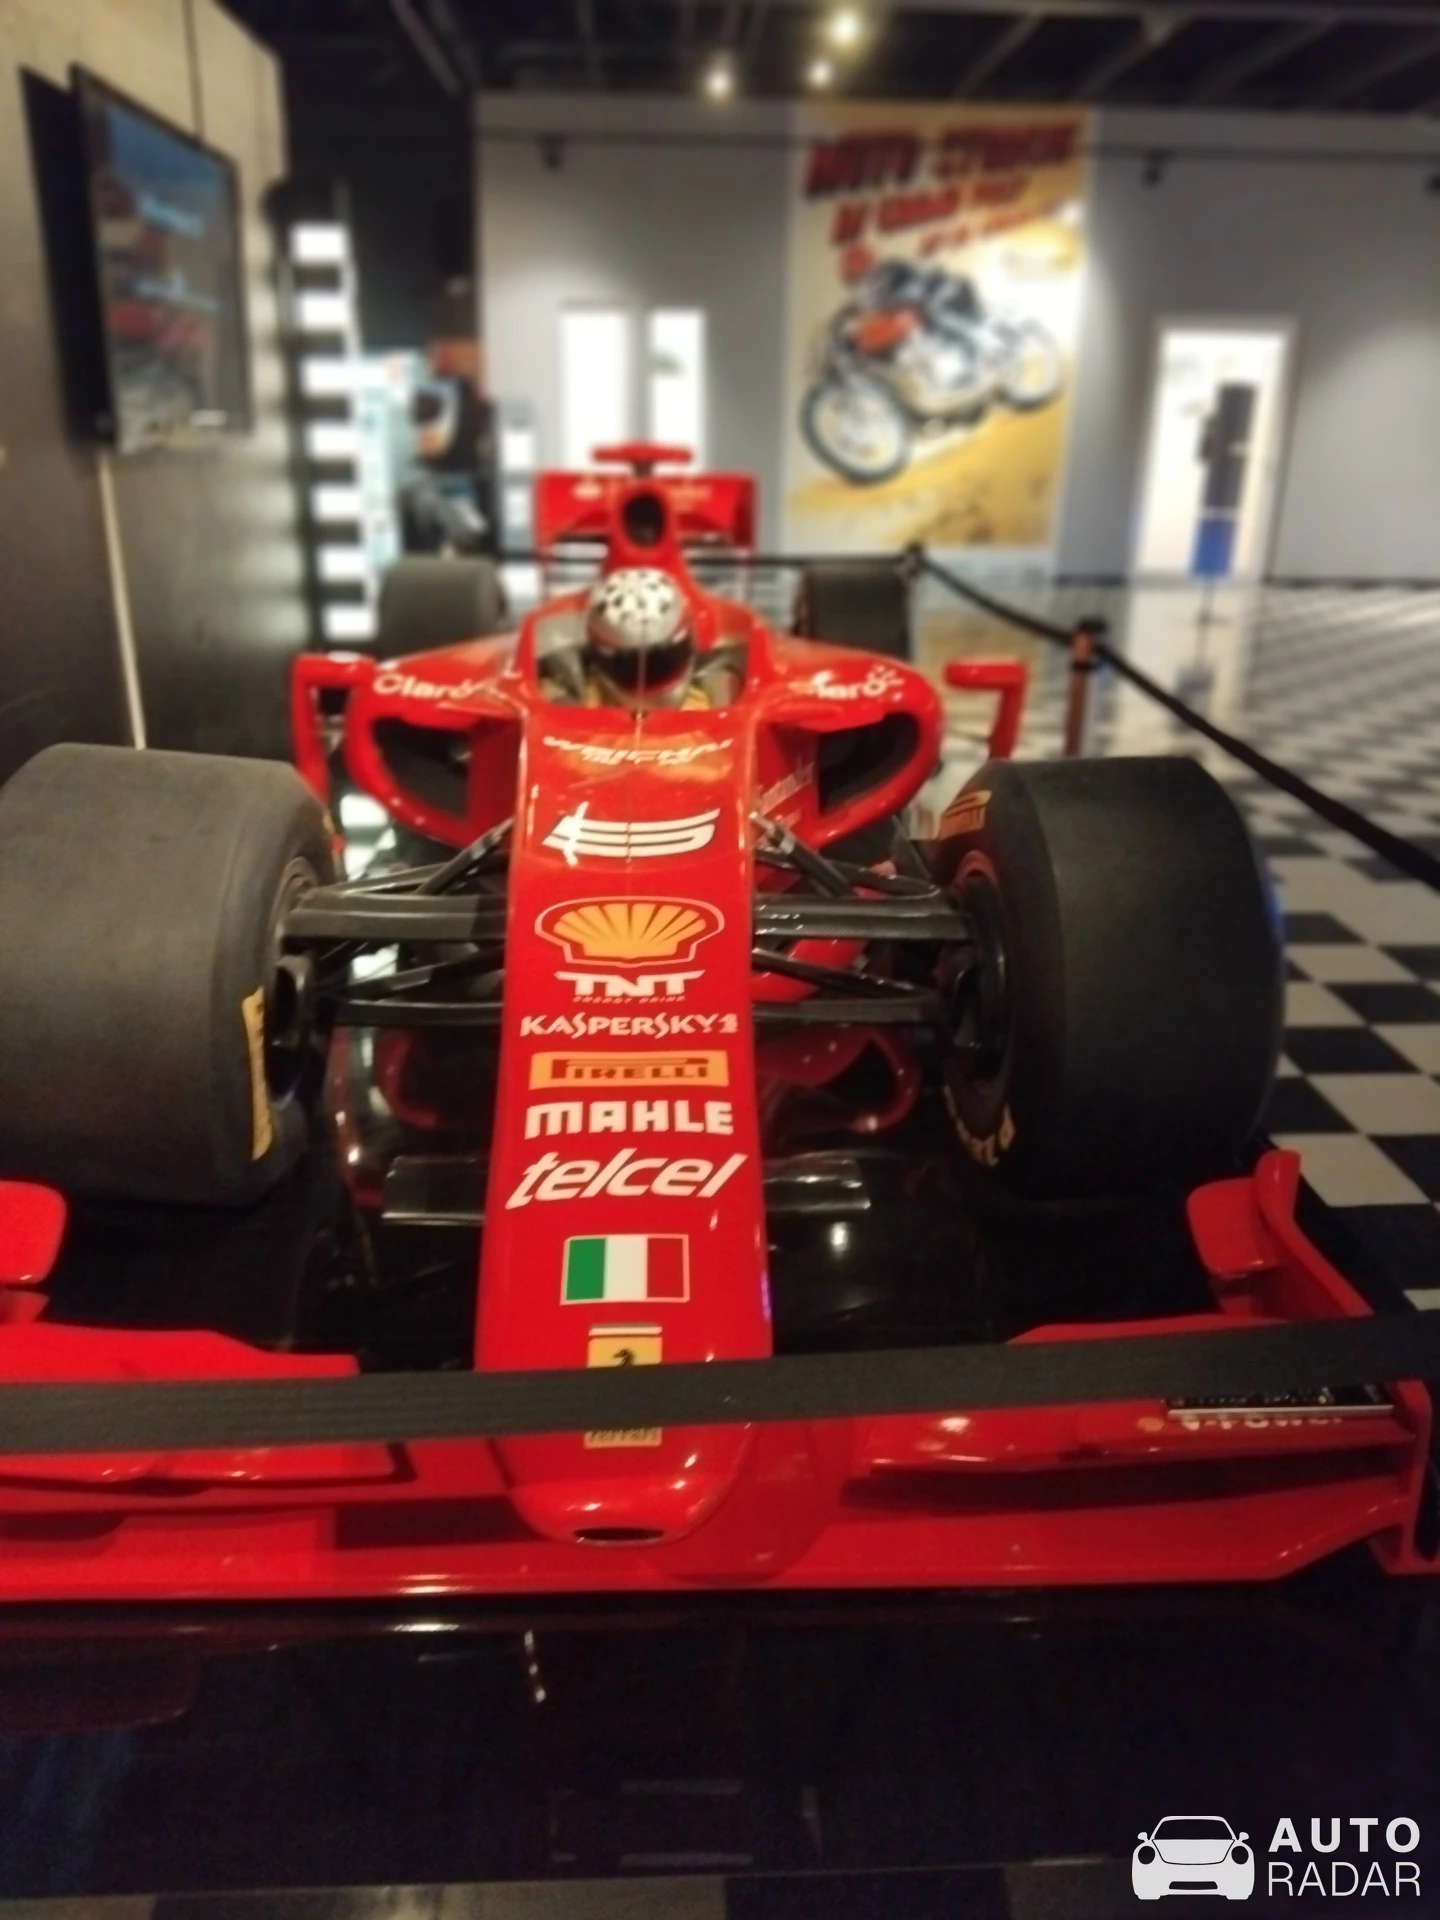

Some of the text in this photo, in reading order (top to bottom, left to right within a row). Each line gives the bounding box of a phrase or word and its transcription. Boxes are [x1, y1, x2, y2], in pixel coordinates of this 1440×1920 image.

[554, 969, 706, 997] TNT
[519, 1012, 720, 1040] KASPERSKY
[551, 1057, 709, 1080] PIRELLI
[524, 1100, 734, 1140] MAHLE
[505, 1148, 748, 1210] telcel
